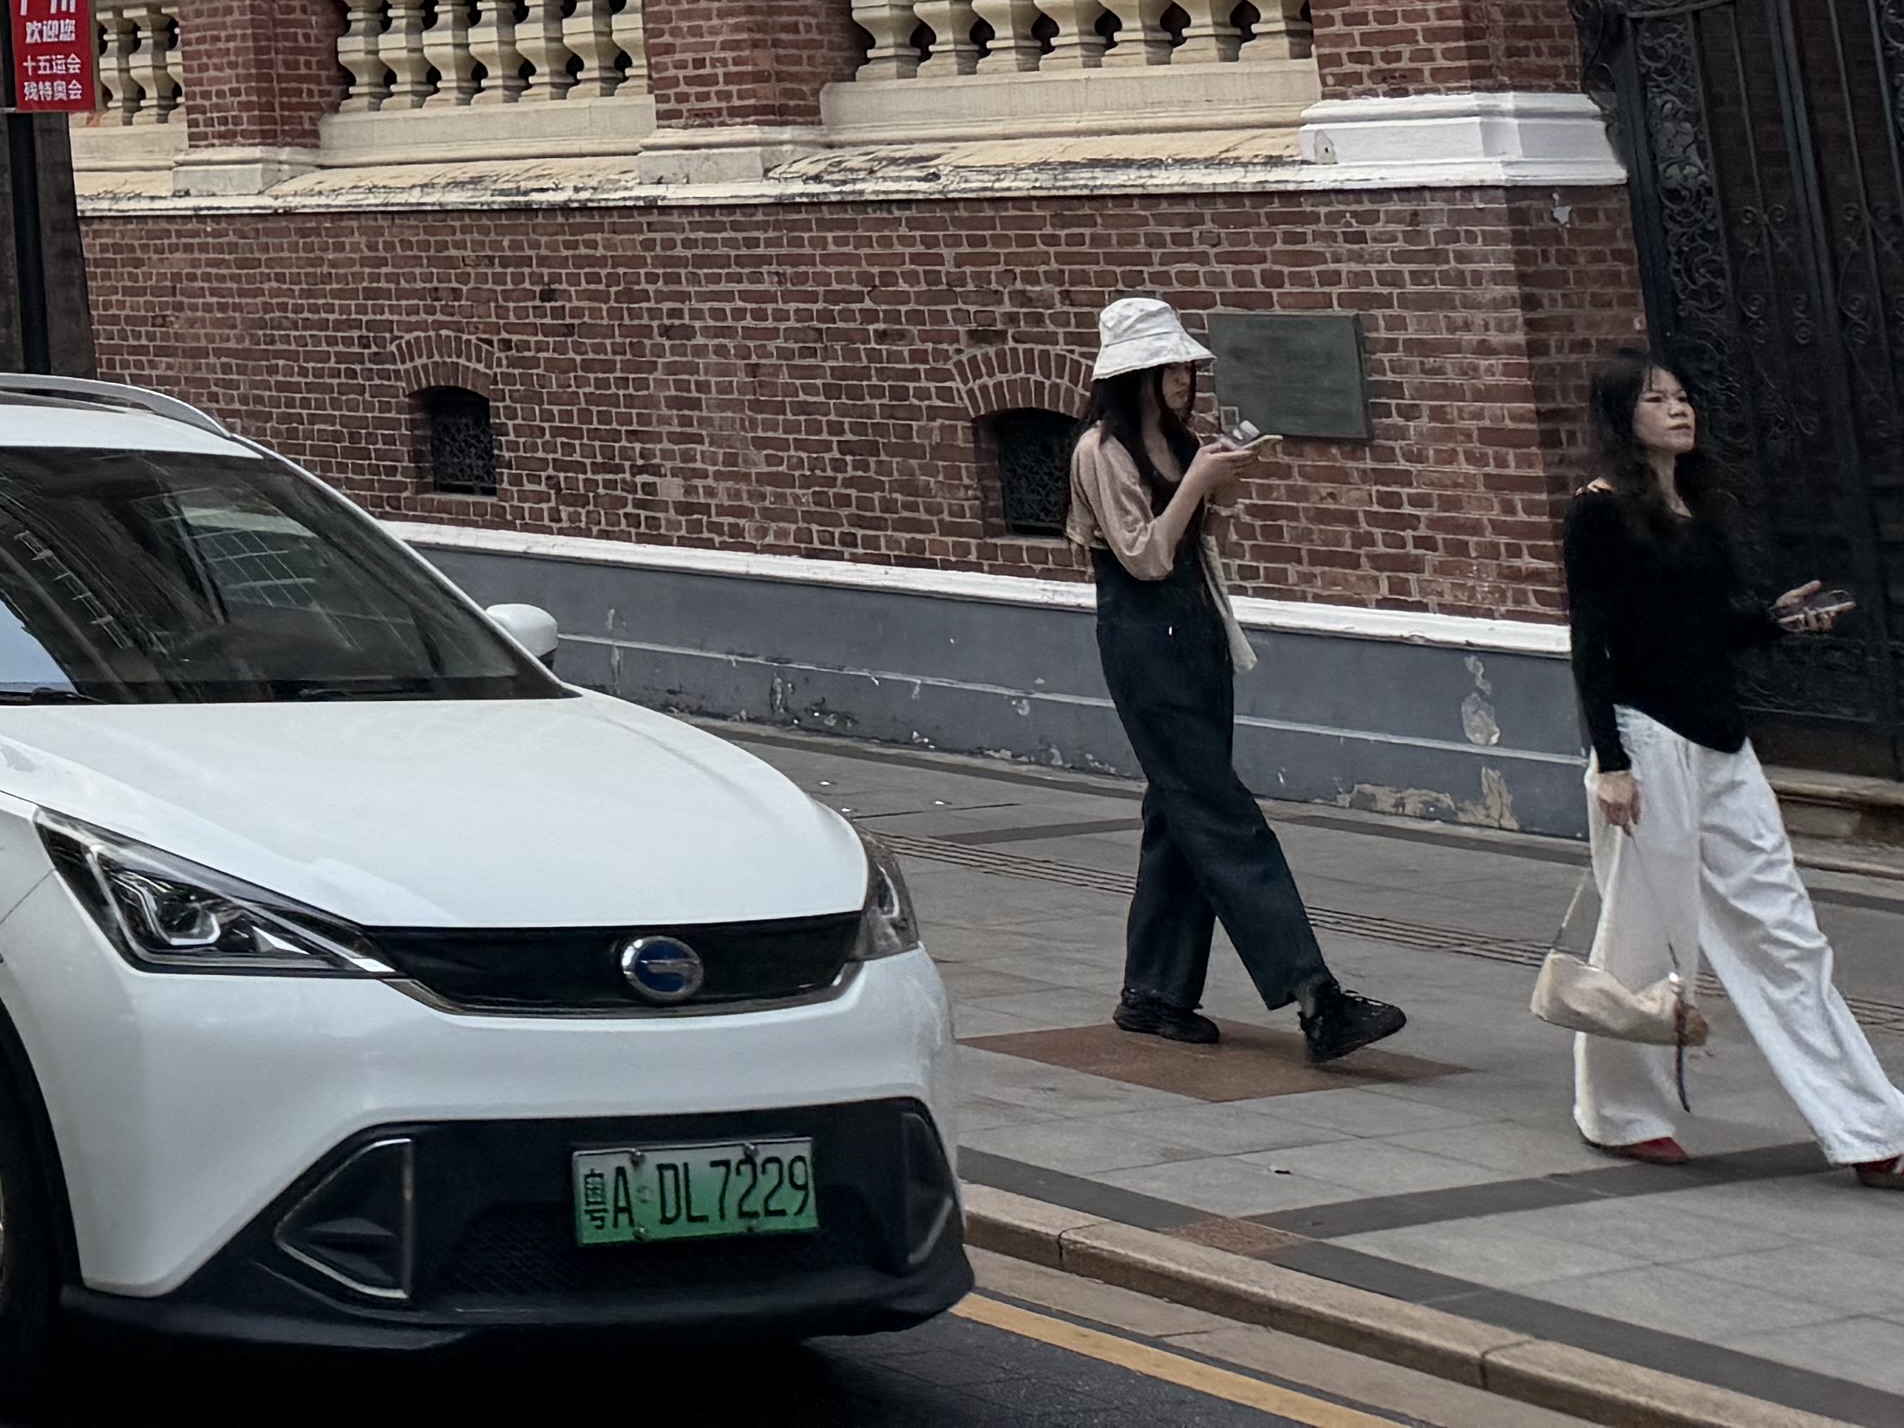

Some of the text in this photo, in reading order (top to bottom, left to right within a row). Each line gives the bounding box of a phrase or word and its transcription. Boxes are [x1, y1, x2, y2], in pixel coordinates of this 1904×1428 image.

[25, 19, 76, 44] 欢迎您
[22, 53, 81, 77] 十五运会
[24, 79, 82, 101] 残特奥会
